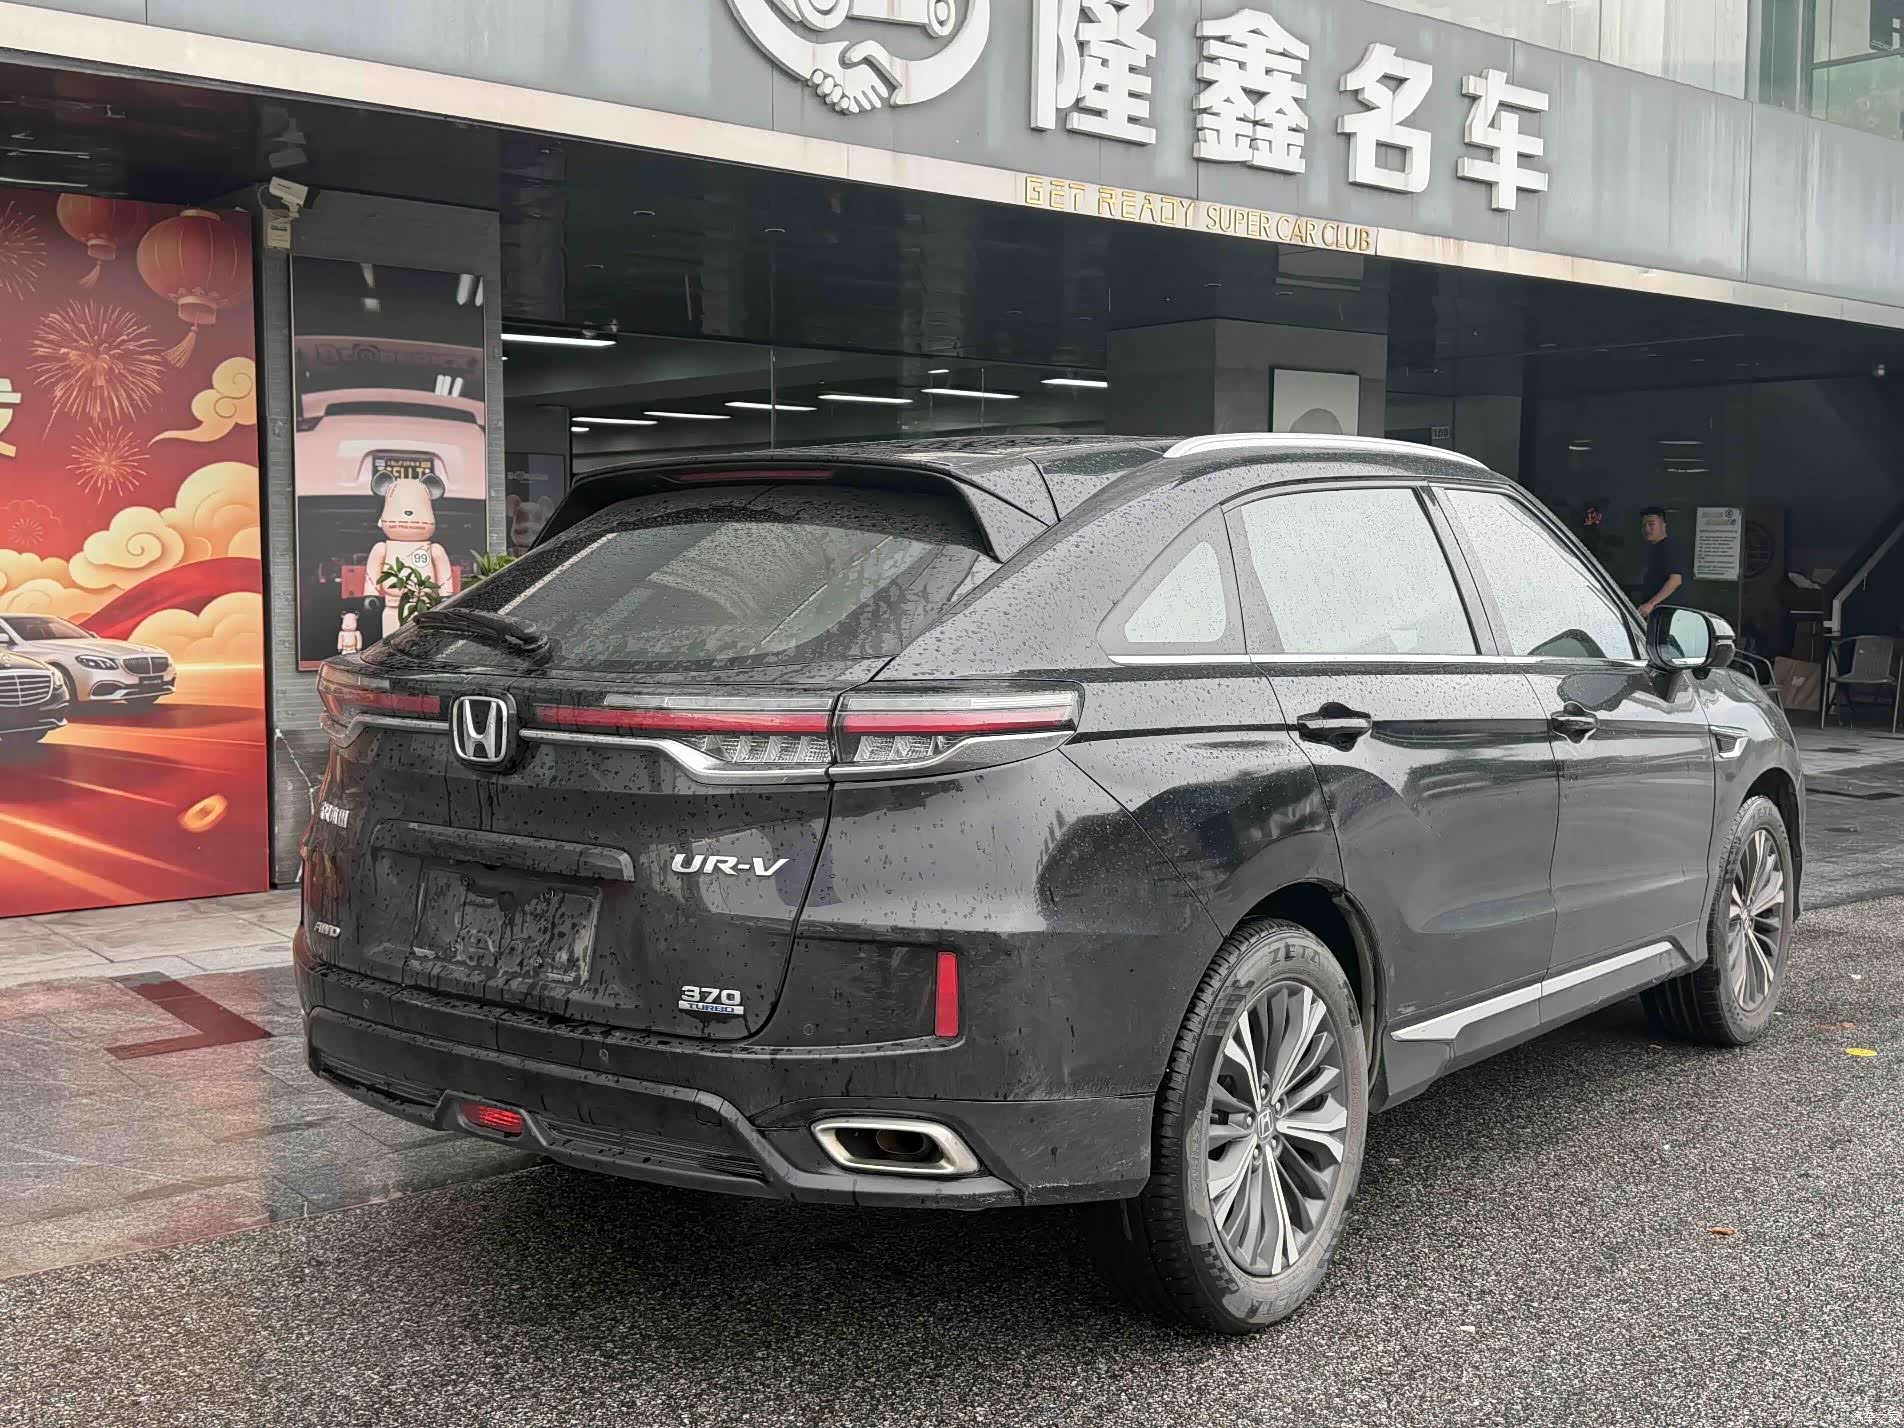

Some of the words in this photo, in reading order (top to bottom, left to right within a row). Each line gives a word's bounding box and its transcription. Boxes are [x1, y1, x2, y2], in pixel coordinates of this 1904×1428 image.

[1030, 0, 1549, 212] 隆鑫名车
[1024, 175, 1087, 212] GET
[1097, 186, 1196, 228] READY
[1206, 205, 1271, 239] SUPER
[1276, 215, 1316, 245] CAR
[1321, 223, 1372, 252] CLUB
[413, 553, 428, 564] 99
[671, 853, 790, 876] UR-V
[314, 921, 341, 938] AWD
[1268, 941, 1321, 968] ZETA
[681, 985, 742, 1006] 370
[687, 1001, 735, 1014] TURBO
